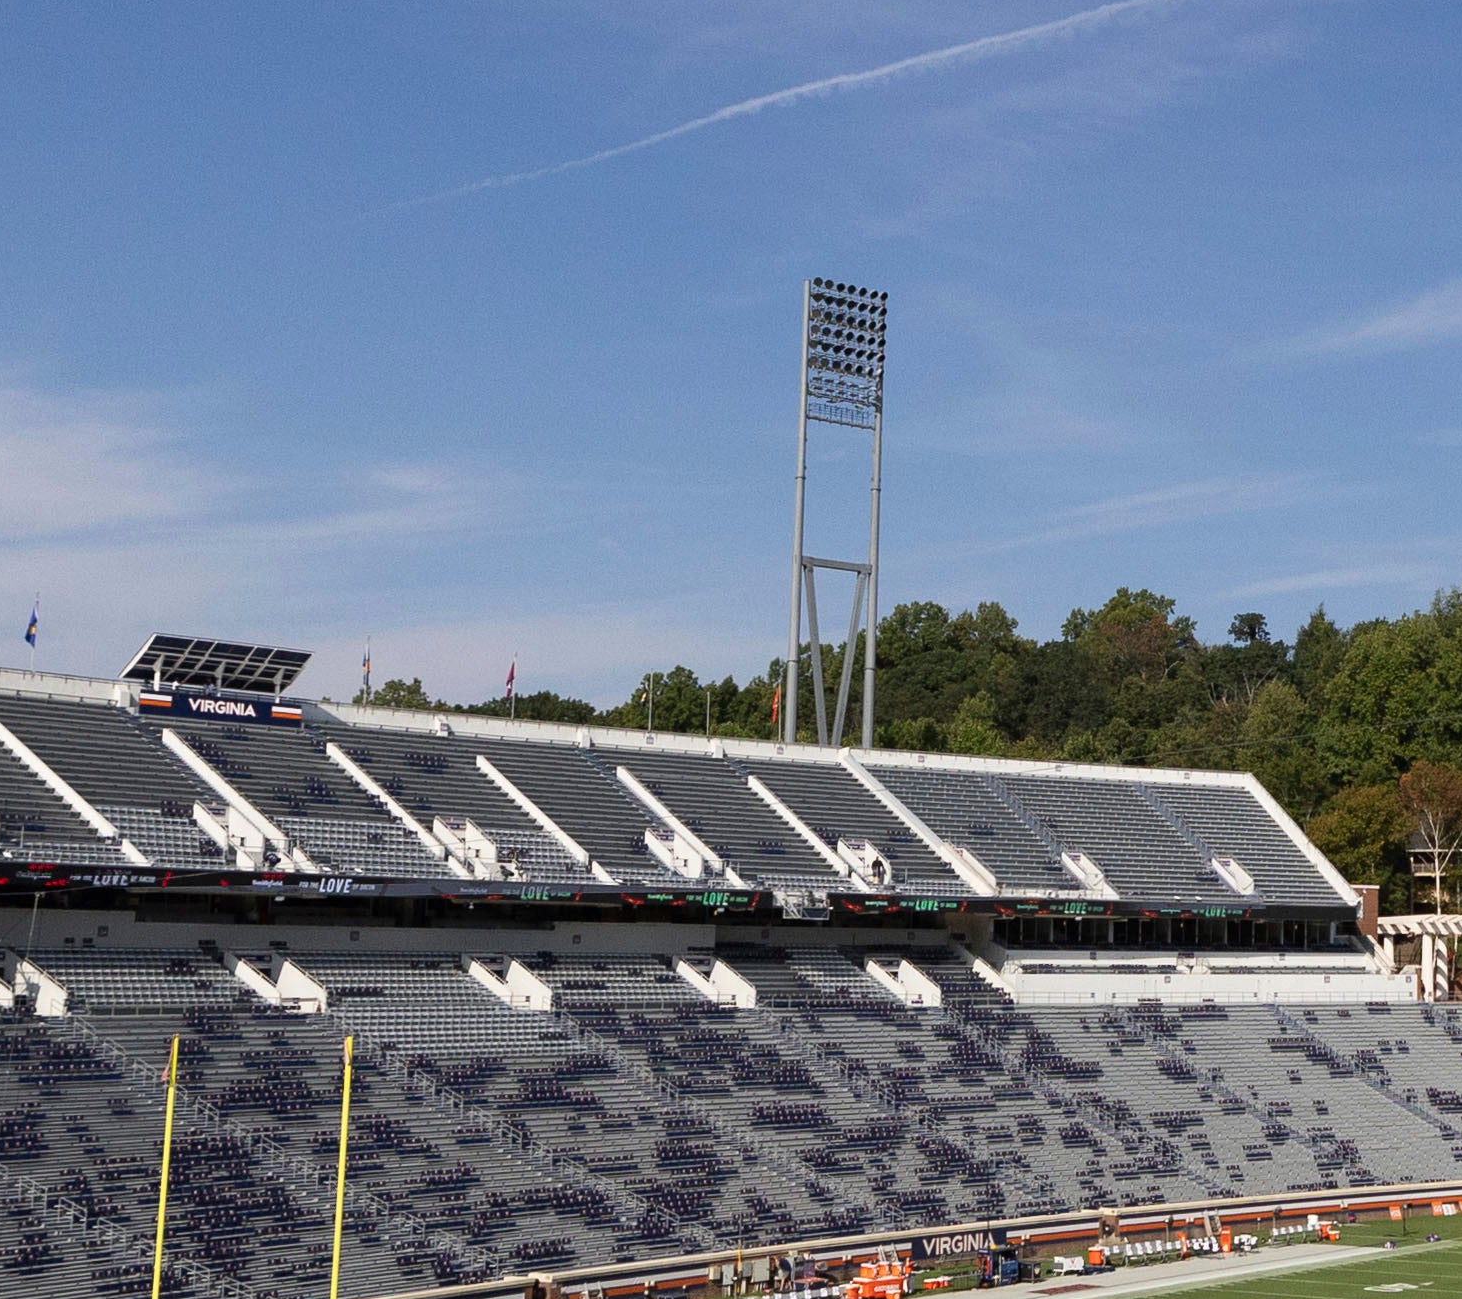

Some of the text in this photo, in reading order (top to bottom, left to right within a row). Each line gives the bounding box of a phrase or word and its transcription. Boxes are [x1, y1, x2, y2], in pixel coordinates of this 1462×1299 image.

[188, 698, 256, 717] VIRGINIA
[319, 878, 353, 893] LOVE
[520, 885, 551, 900] LOVE
[702, 892, 730, 906] LOVE
[1063, 902, 1088, 914] LOVE
[922, 1232, 995, 1256] VIRGINIA
